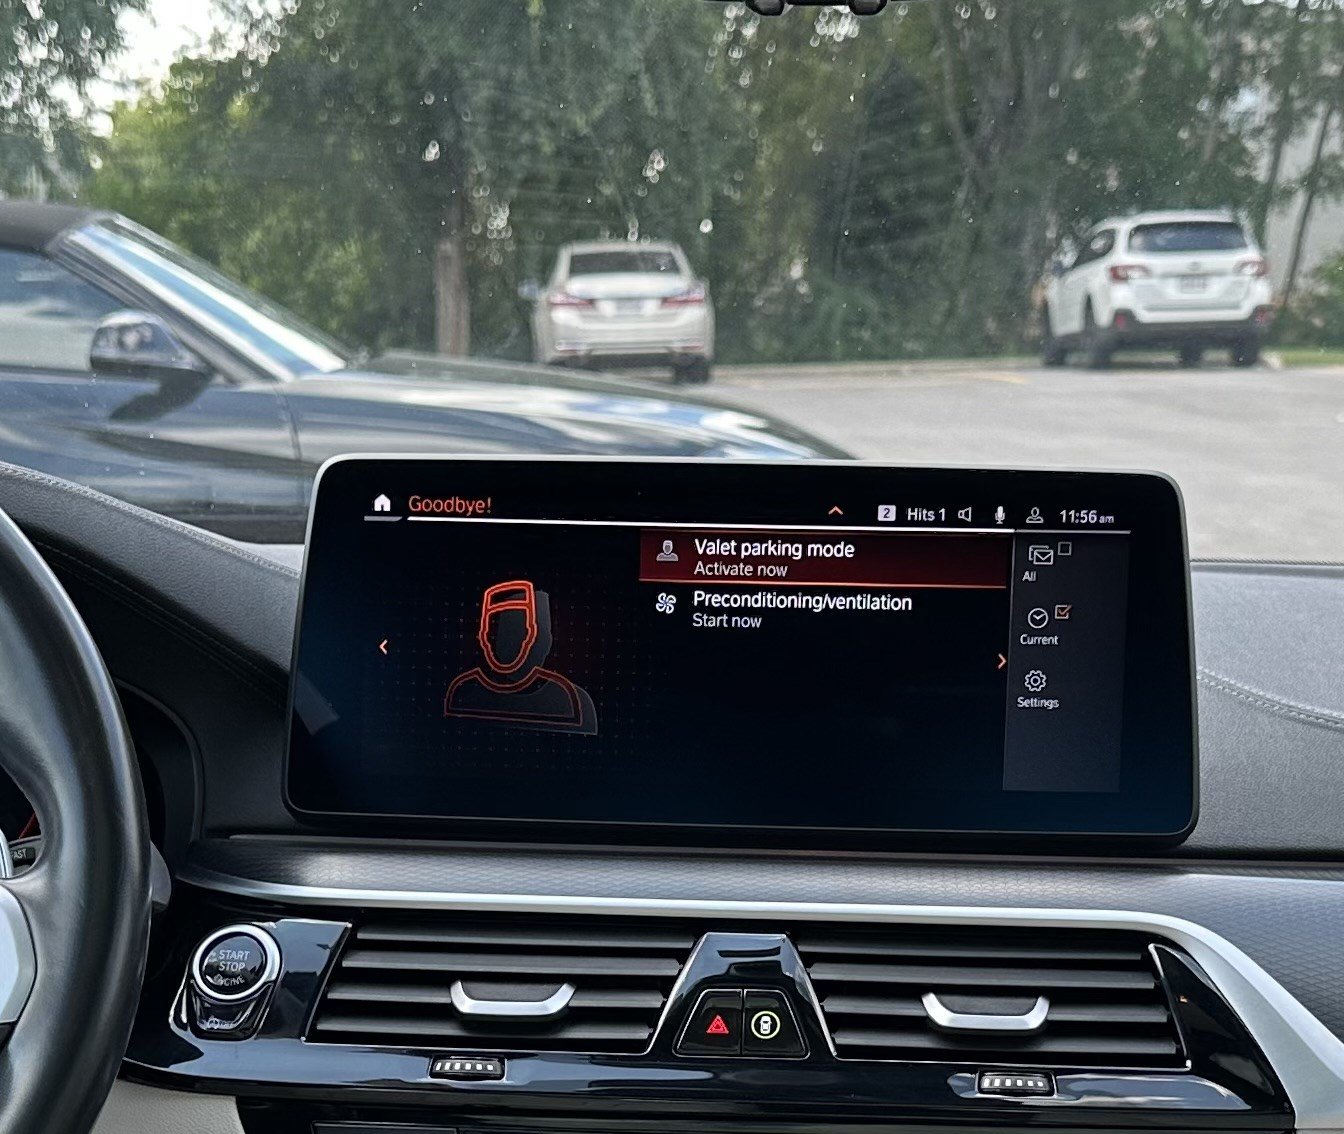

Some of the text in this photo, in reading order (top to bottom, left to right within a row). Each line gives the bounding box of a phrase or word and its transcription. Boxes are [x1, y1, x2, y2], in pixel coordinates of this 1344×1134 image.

[408, 495, 492, 516] Goodbye!
[907, 507, 934, 521] Hits
[938, 507, 947, 521] 1
[1059, 510, 1098, 525] 11:56
[694, 539, 855, 562] Valet parking mode
[694, 561, 788, 578] Activate now
[1022, 571, 1037, 582] All
[693, 591, 913, 613] Preconditioning/ventilation
[693, 613, 762, 629] Start now
[1019, 634, 1059, 647] Current
[1017, 697, 1060, 710] Settings
[219, 949, 251, 961] START
[218, 961, 246, 972] STOP
